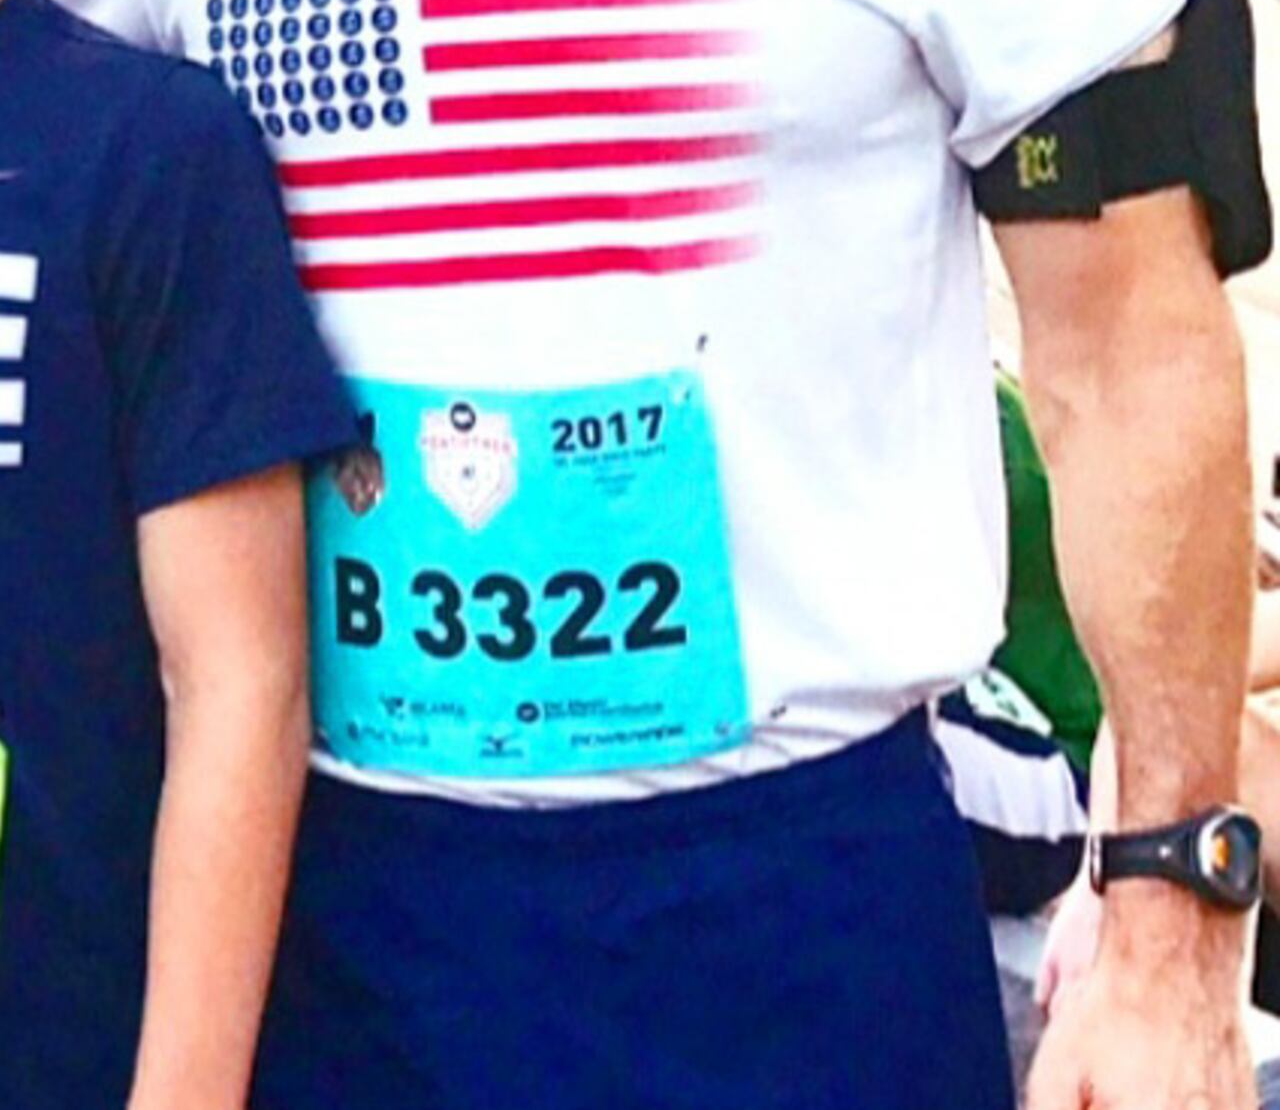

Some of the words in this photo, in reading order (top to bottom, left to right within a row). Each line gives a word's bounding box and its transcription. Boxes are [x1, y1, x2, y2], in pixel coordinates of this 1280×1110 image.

[551, 405, 663, 454] 2017
[334, 555, 384, 650] B
[410, 560, 687, 662] 3322
